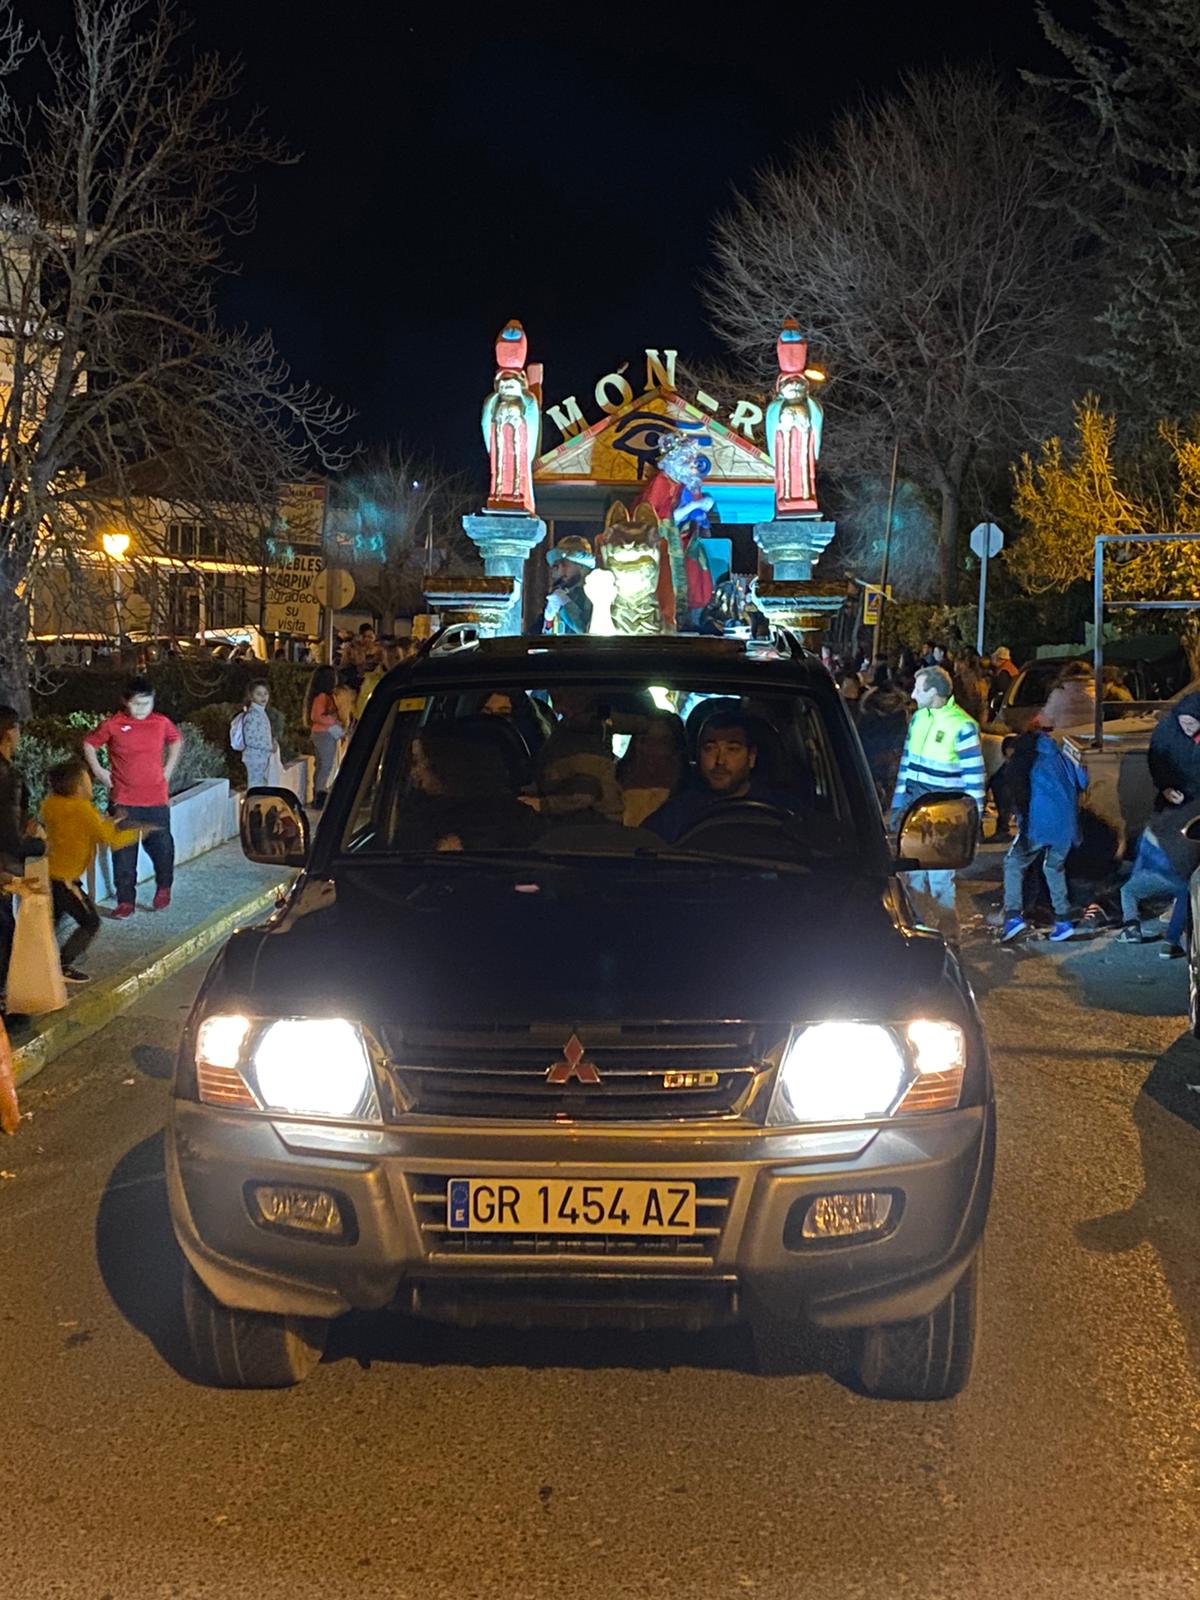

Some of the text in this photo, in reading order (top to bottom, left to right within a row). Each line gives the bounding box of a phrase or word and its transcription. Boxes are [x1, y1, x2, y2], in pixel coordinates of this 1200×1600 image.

[285, 606, 299, 617] su
[278, 618, 306, 632] visita
[472, 1185, 690, 1228] GR 1454 AZ
[455, 1209, 465, 1222] E
